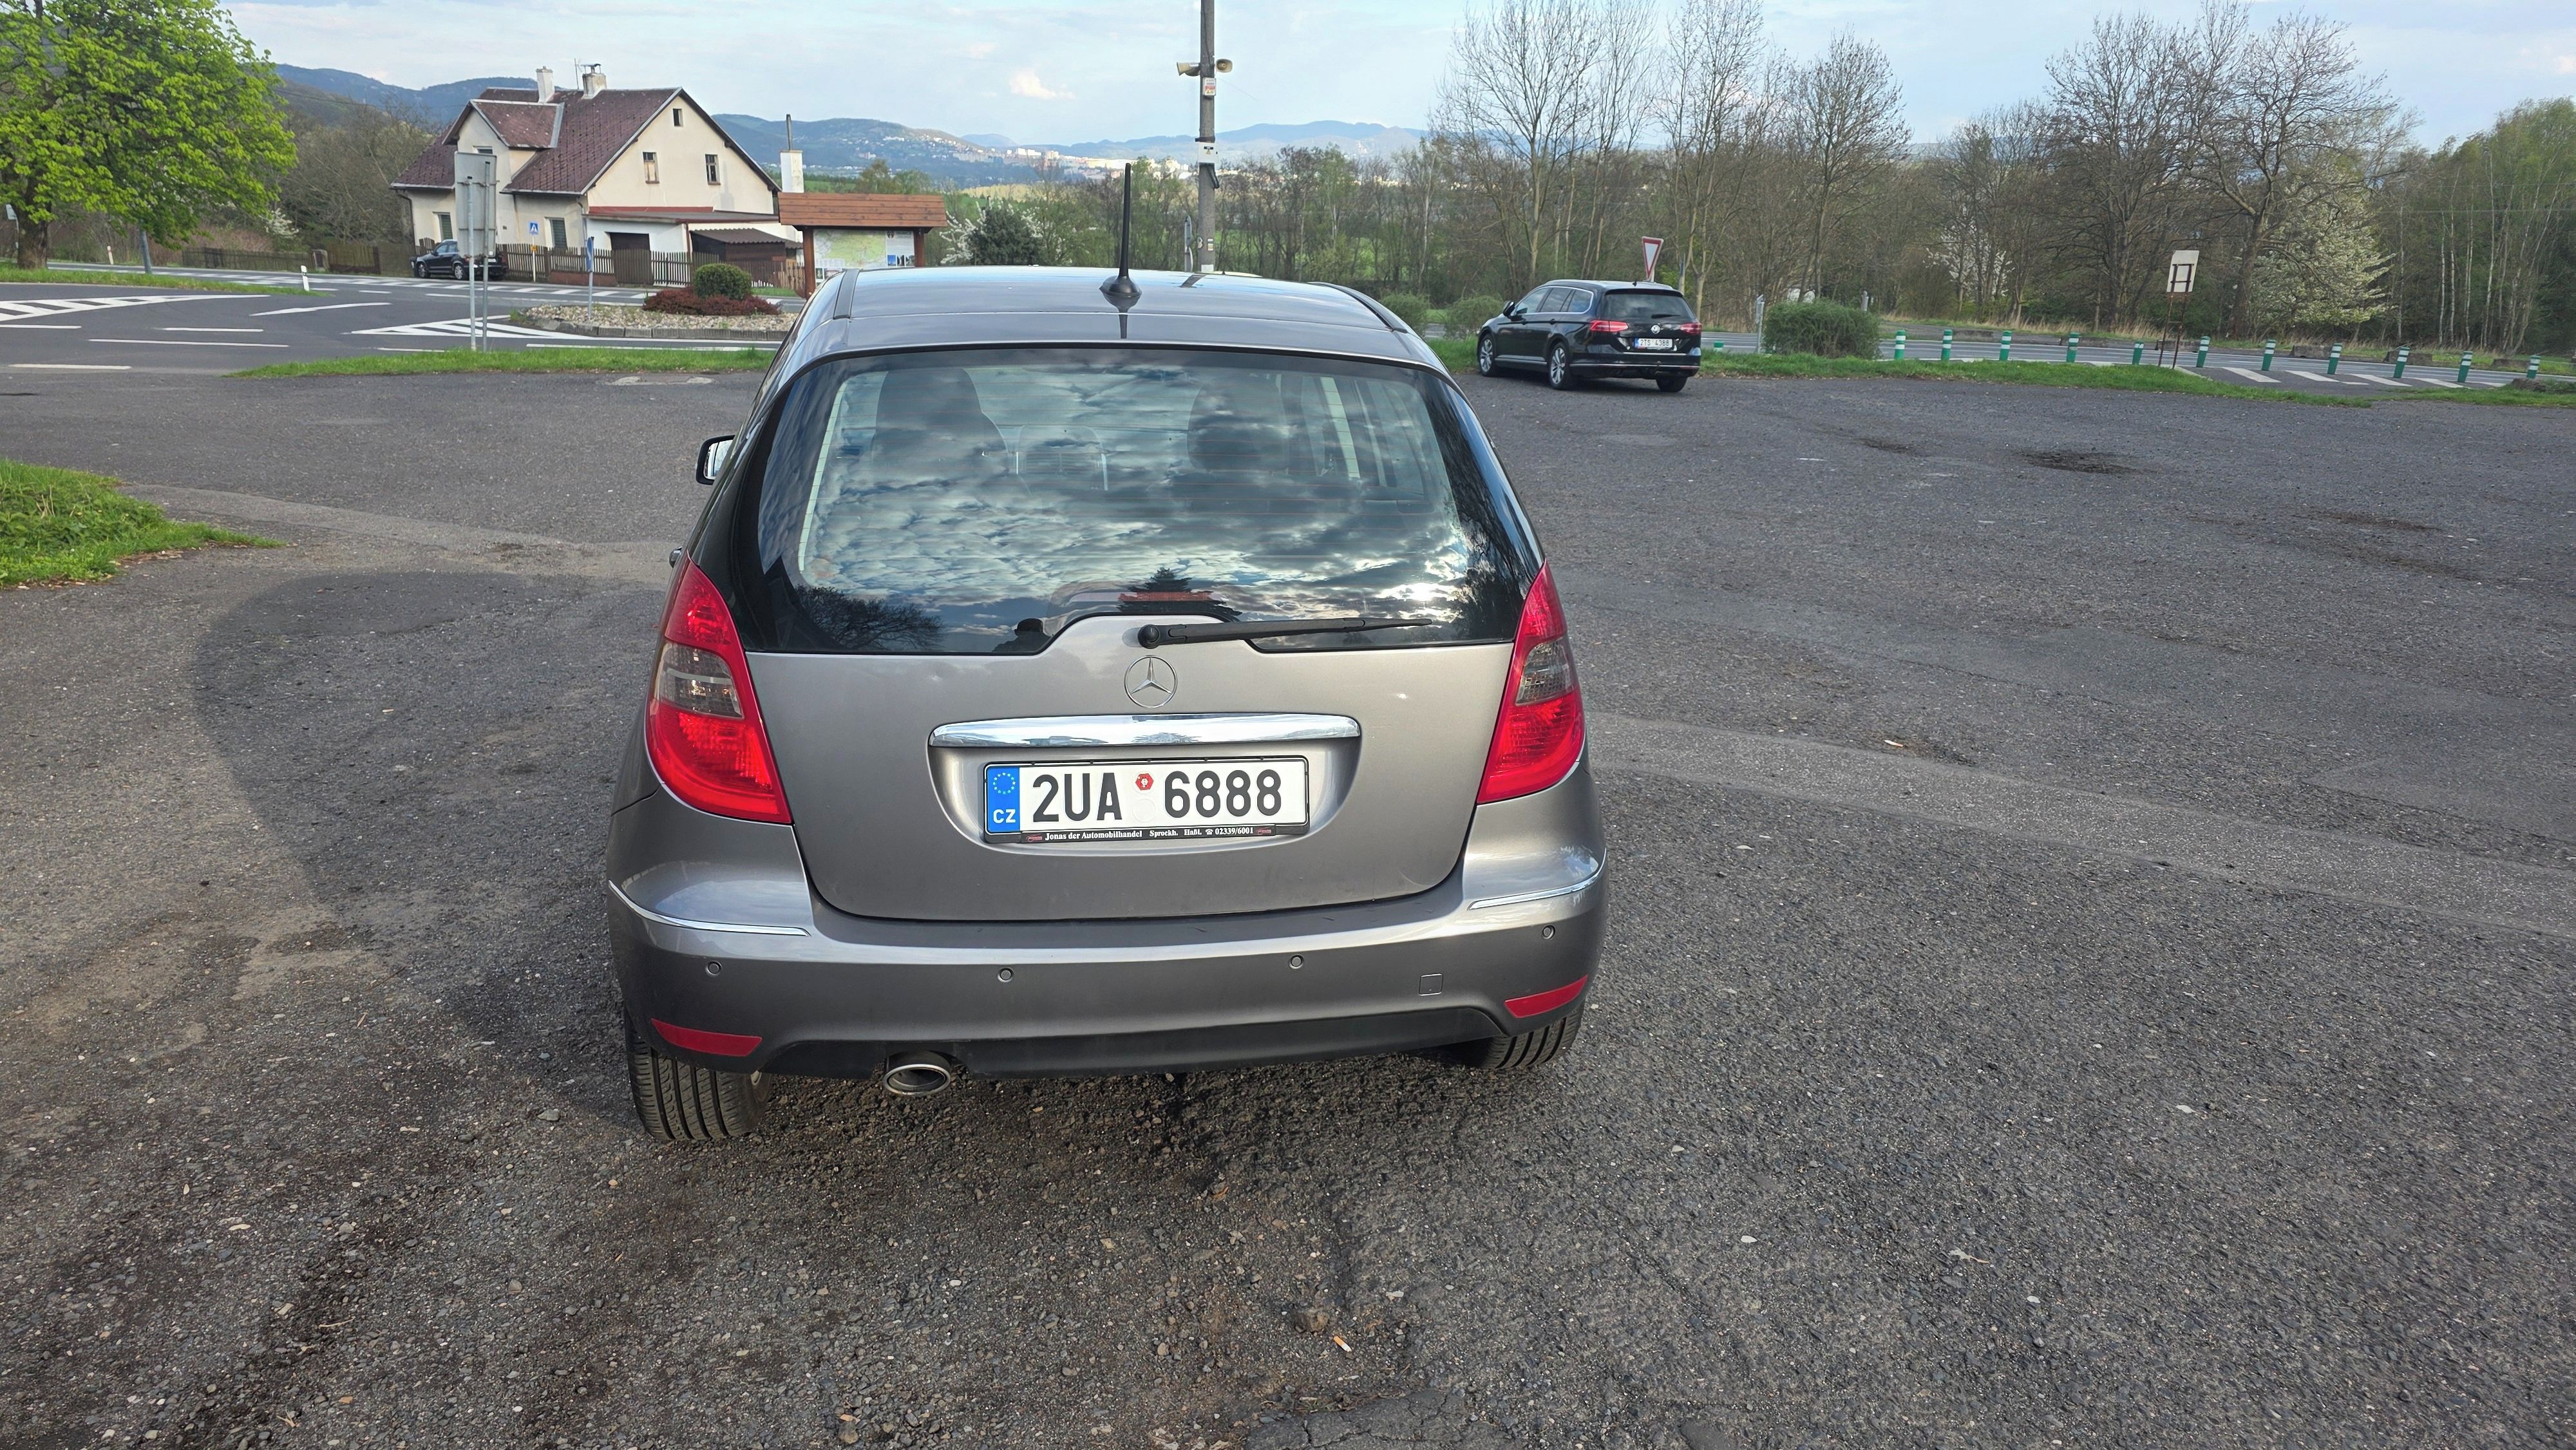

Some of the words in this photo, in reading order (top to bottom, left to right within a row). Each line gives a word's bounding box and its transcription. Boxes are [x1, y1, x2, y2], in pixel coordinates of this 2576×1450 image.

[1032, 773, 1122, 822] 2UA
[1164, 769, 1282, 818] 6888
[993, 809, 1016, 824] CZ
[1045, 833, 1066, 841] Jonas
[1081, 830, 1142, 840] Automobilhandel
[1149, 829, 1179, 838] Sprockh.
[1215, 827, 1254, 835] 02339/6001
